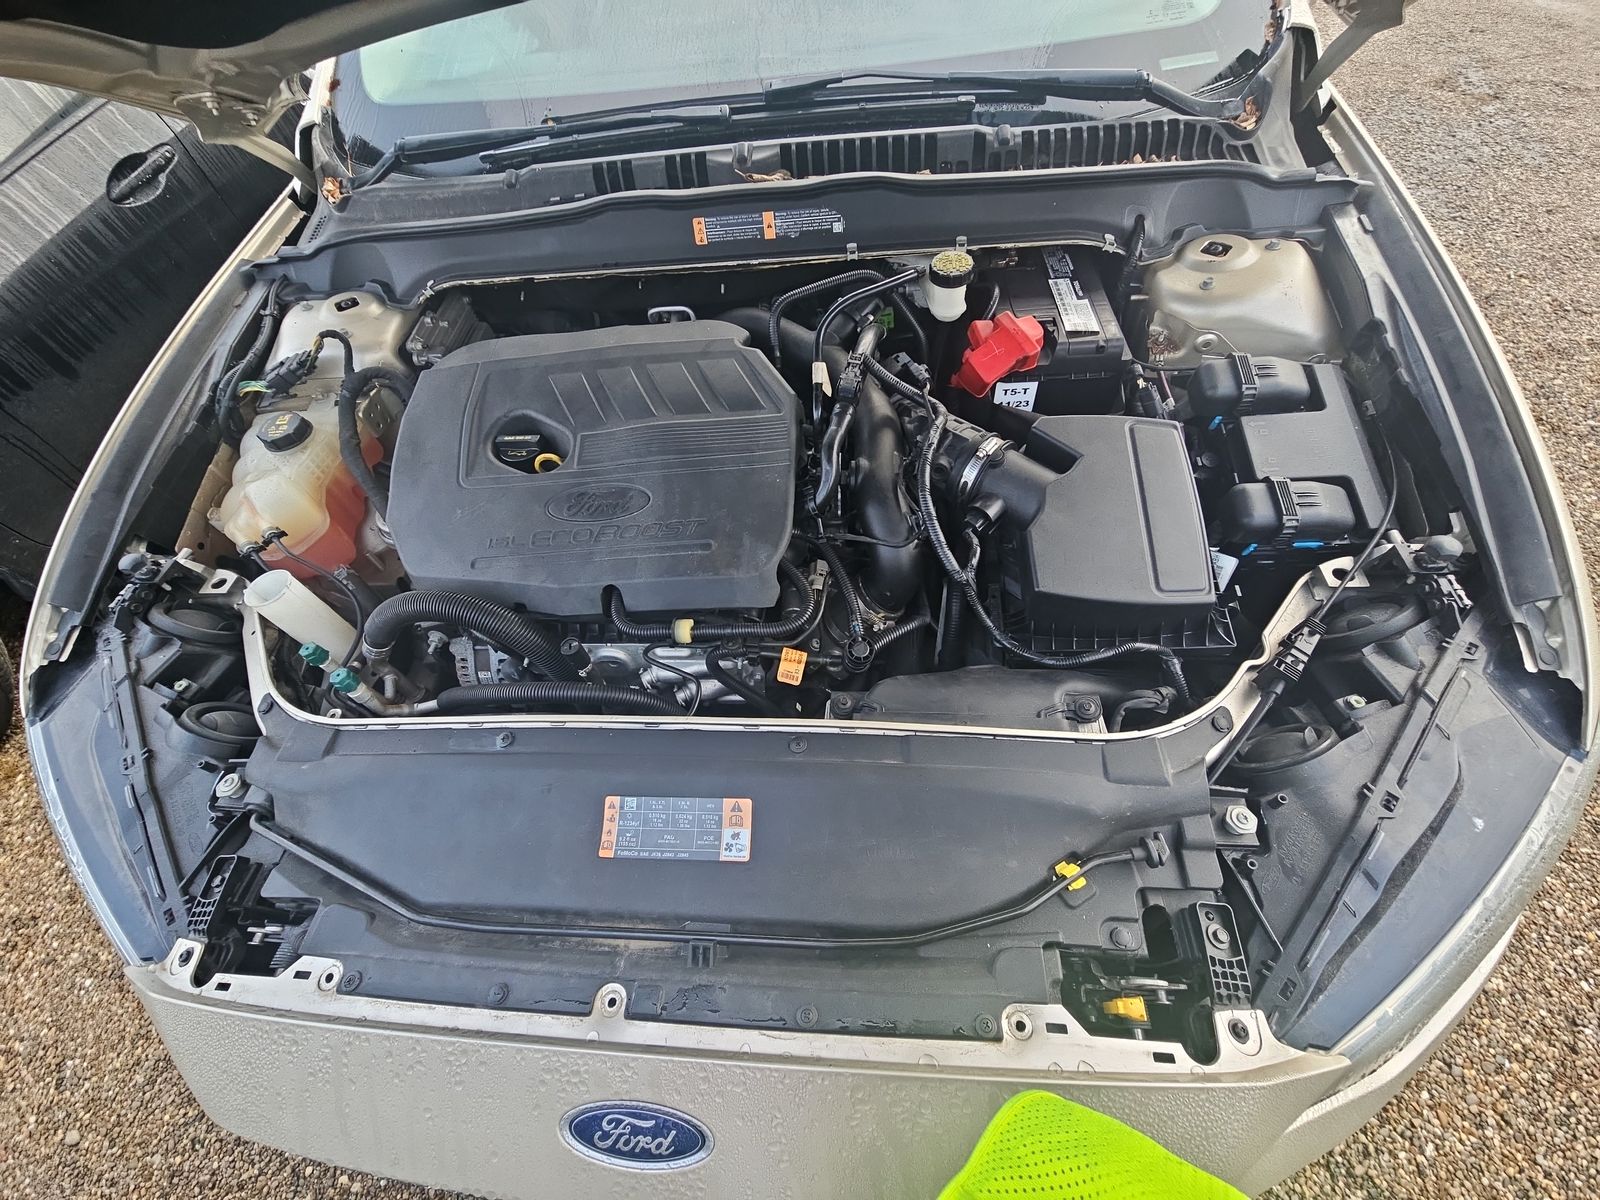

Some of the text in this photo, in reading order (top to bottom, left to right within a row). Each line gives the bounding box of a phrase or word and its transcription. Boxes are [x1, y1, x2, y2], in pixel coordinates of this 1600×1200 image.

[1002, 387, 1030, 396] T5-T
[564, 491, 634, 518] Ford
[529, 519, 708, 549] ECOBOOST
[593, 1114, 677, 1156] Ford
